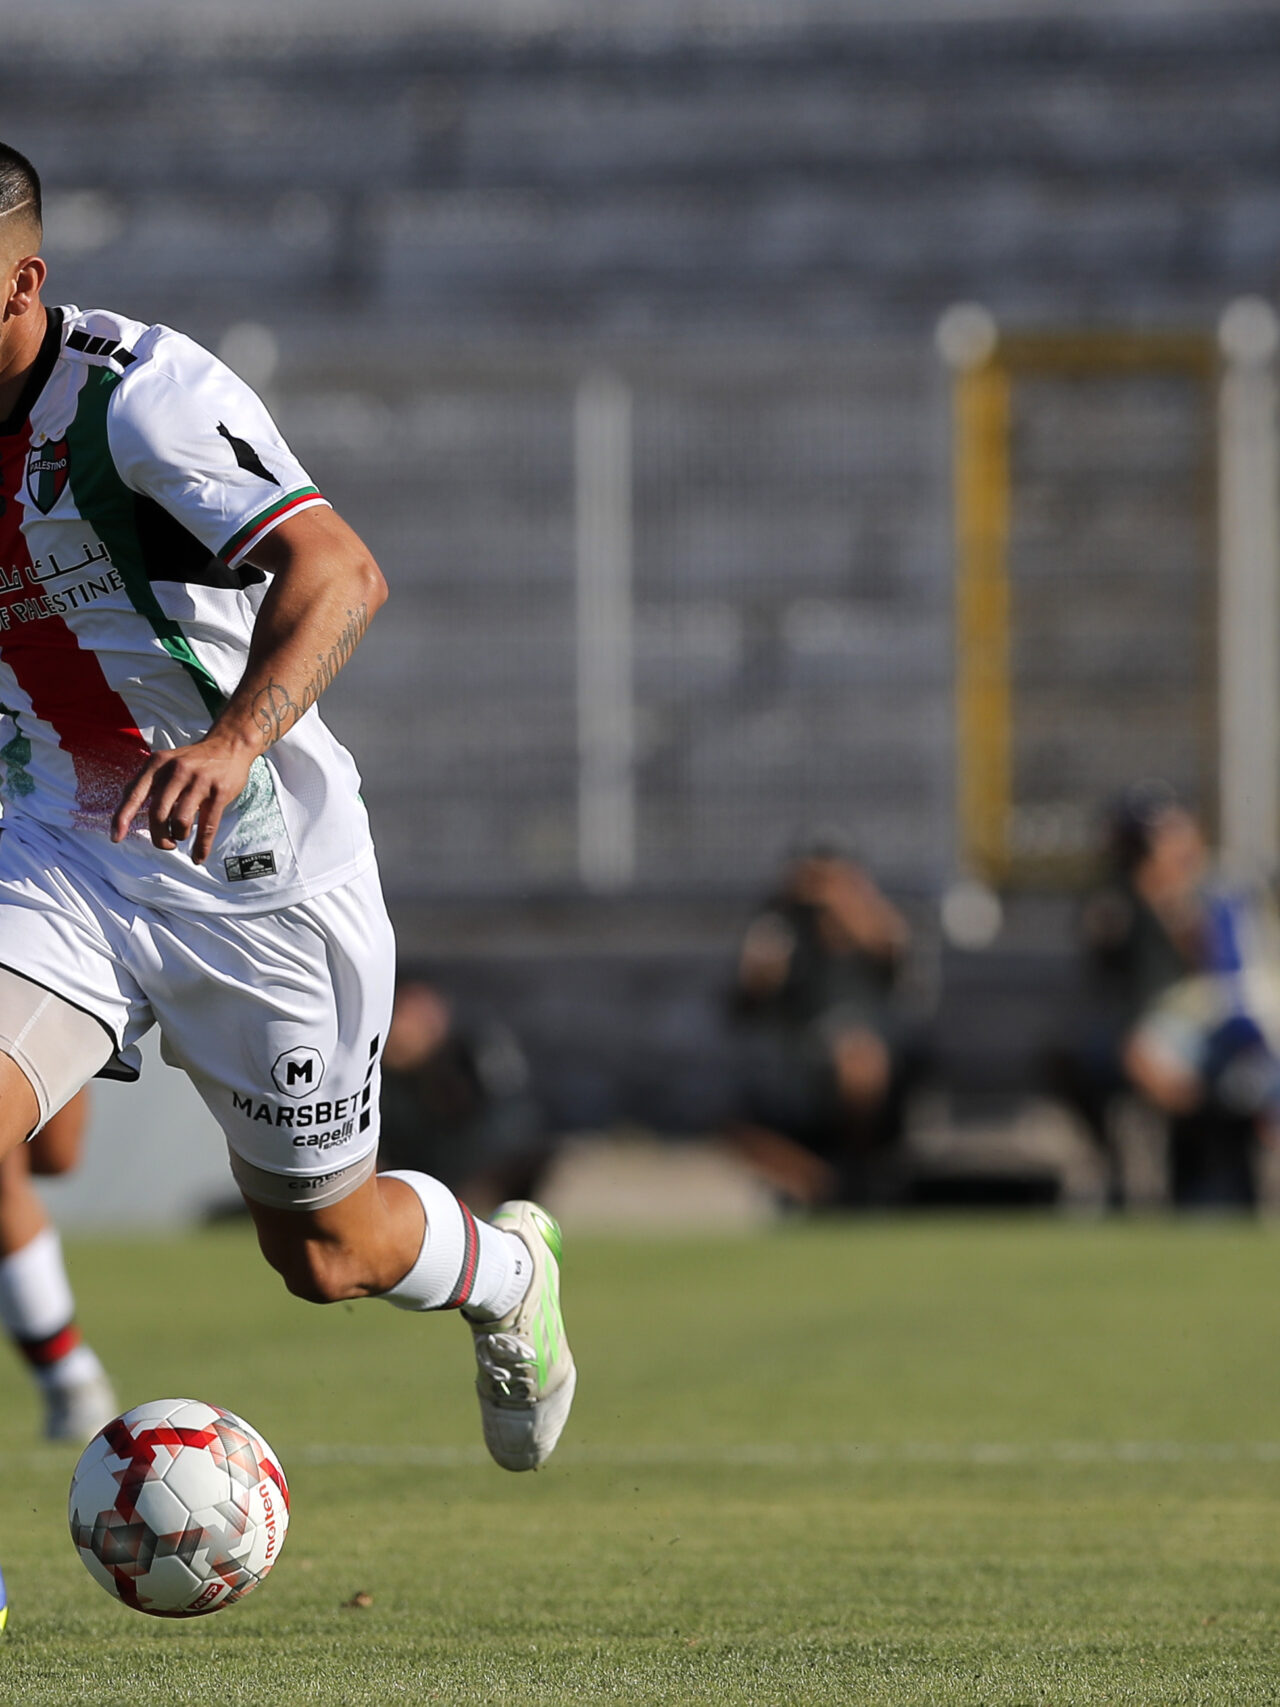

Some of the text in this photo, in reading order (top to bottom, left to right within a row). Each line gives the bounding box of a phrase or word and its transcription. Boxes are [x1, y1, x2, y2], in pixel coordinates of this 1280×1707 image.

[30, 458, 67, 473] PALESTINO
[10, 567, 126, 624] PALESTINE
[286, 1059, 313, 1085] M
[232, 1091, 361, 1128] MARSBET
[293, 1118, 354, 1149] capelli
[323, 1133, 353, 1150] SPORT
[258, 1484, 277, 1560] molten
